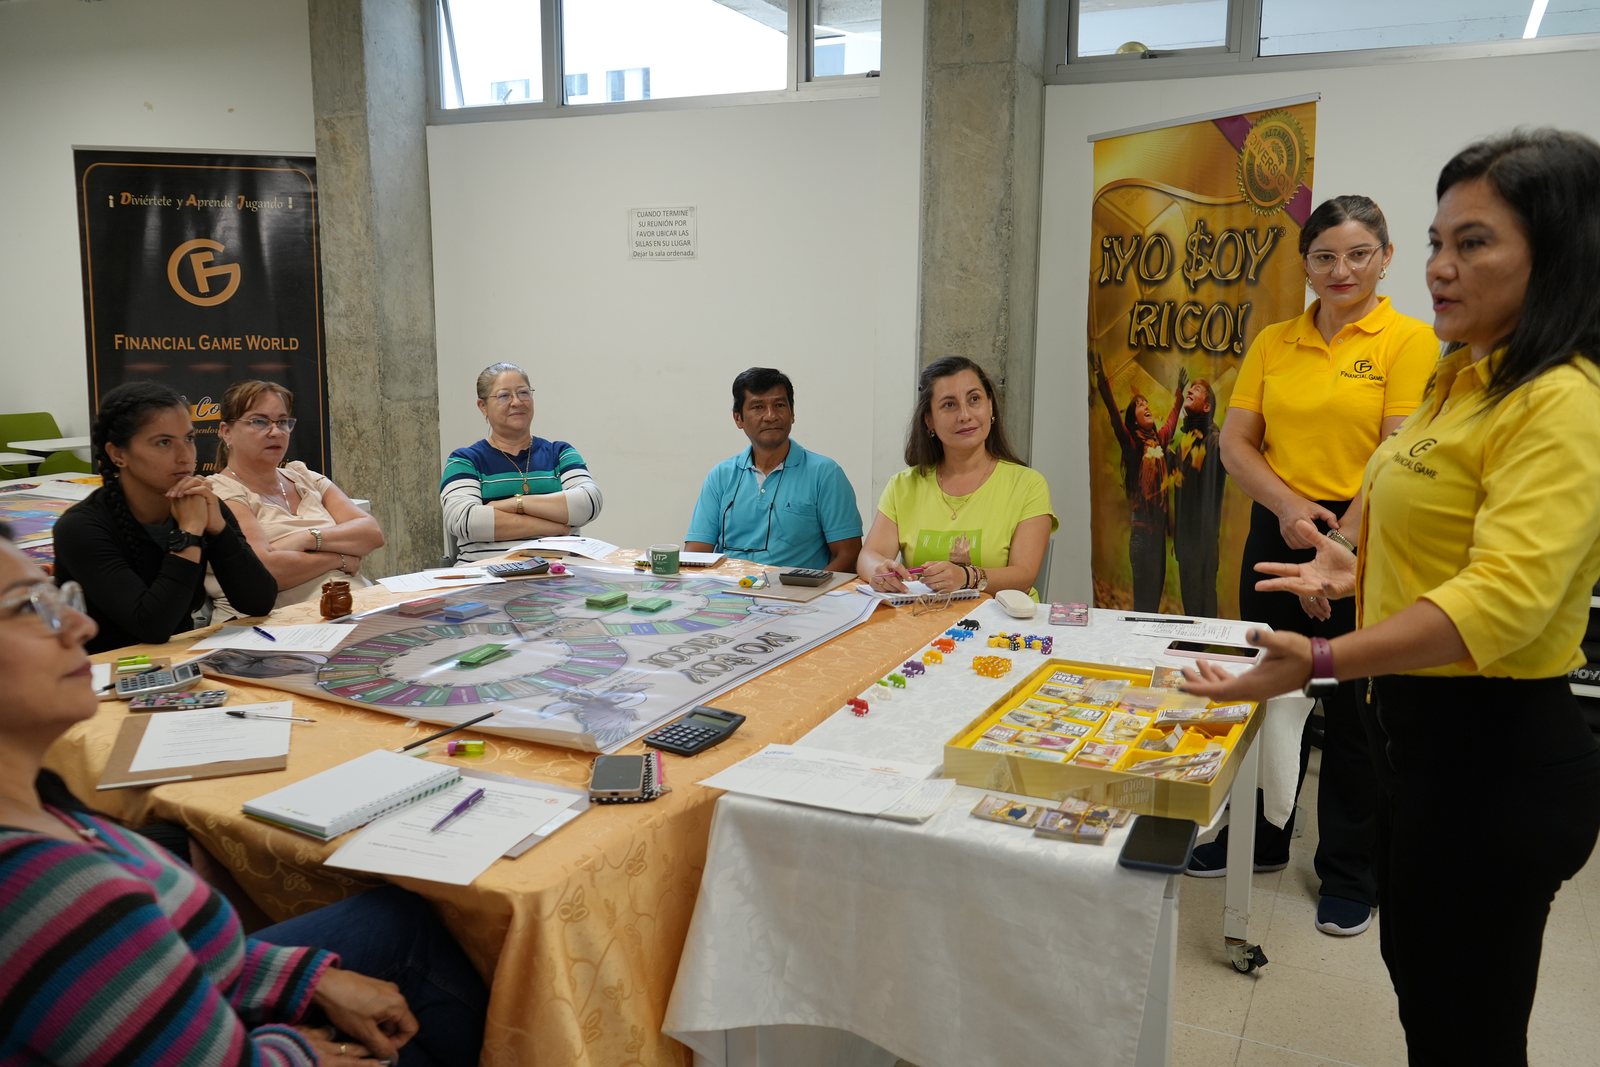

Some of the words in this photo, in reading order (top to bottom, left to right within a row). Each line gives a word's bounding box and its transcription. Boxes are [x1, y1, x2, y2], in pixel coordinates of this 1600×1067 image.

[119, 191, 172, 207] Diviértete
[176, 199, 184, 210] y
[185, 193, 233, 210] Aprende
[236, 194, 284, 212] Jugando
[636, 210, 661, 218] CUANDO
[662, 209, 689, 217] TERMINE
[638, 220, 646, 228] SU
[674, 219, 687, 227] POR
[678, 229, 689, 237] LAS
[671, 239, 691, 247] LUGAR
[632, 250, 647, 258] Dejar
[1128, 300, 1250, 354] RICO!
[113, 333, 195, 351] FINANCIAL
[198, 333, 242, 351] GAME
[245, 334, 299, 351] WORLD
